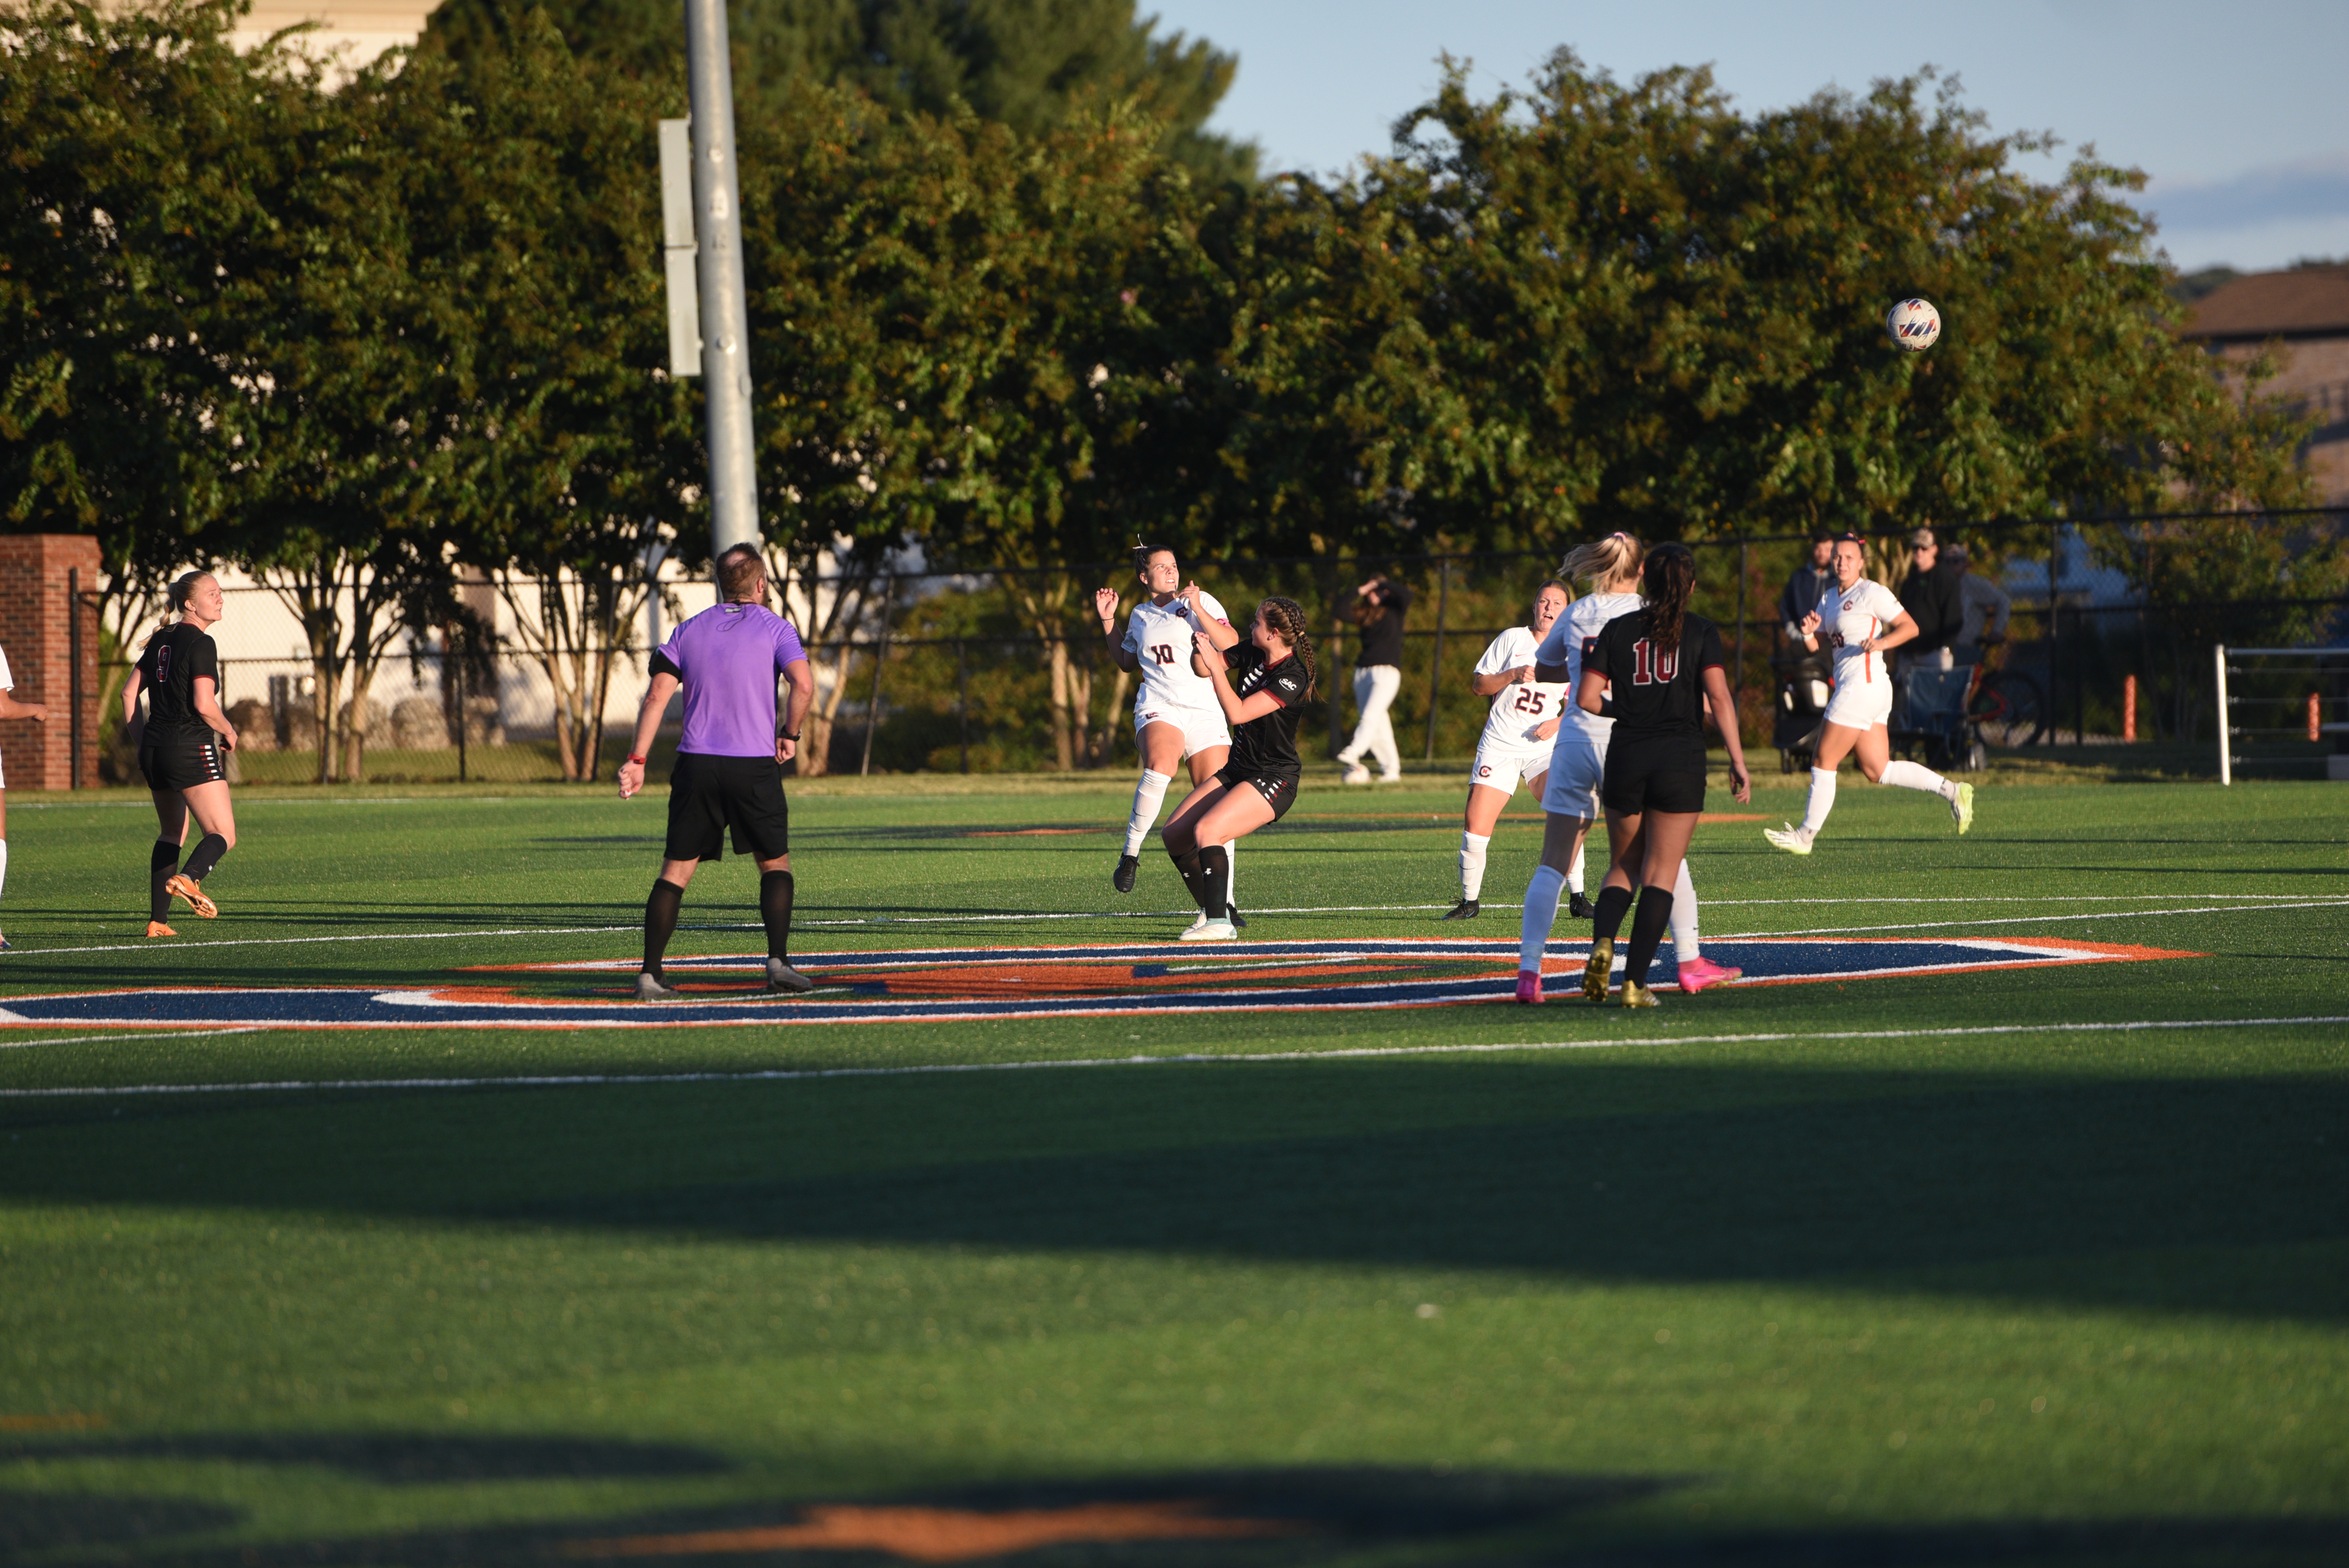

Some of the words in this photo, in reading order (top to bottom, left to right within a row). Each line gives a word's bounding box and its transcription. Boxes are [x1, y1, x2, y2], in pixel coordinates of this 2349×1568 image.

[156, 644, 172, 683] 9
[1150, 643, 1176, 667] 10
[1632, 637, 1680, 686] 10
[1280, 678, 1297, 691] SAC
[1514, 686, 1547, 716] 25
